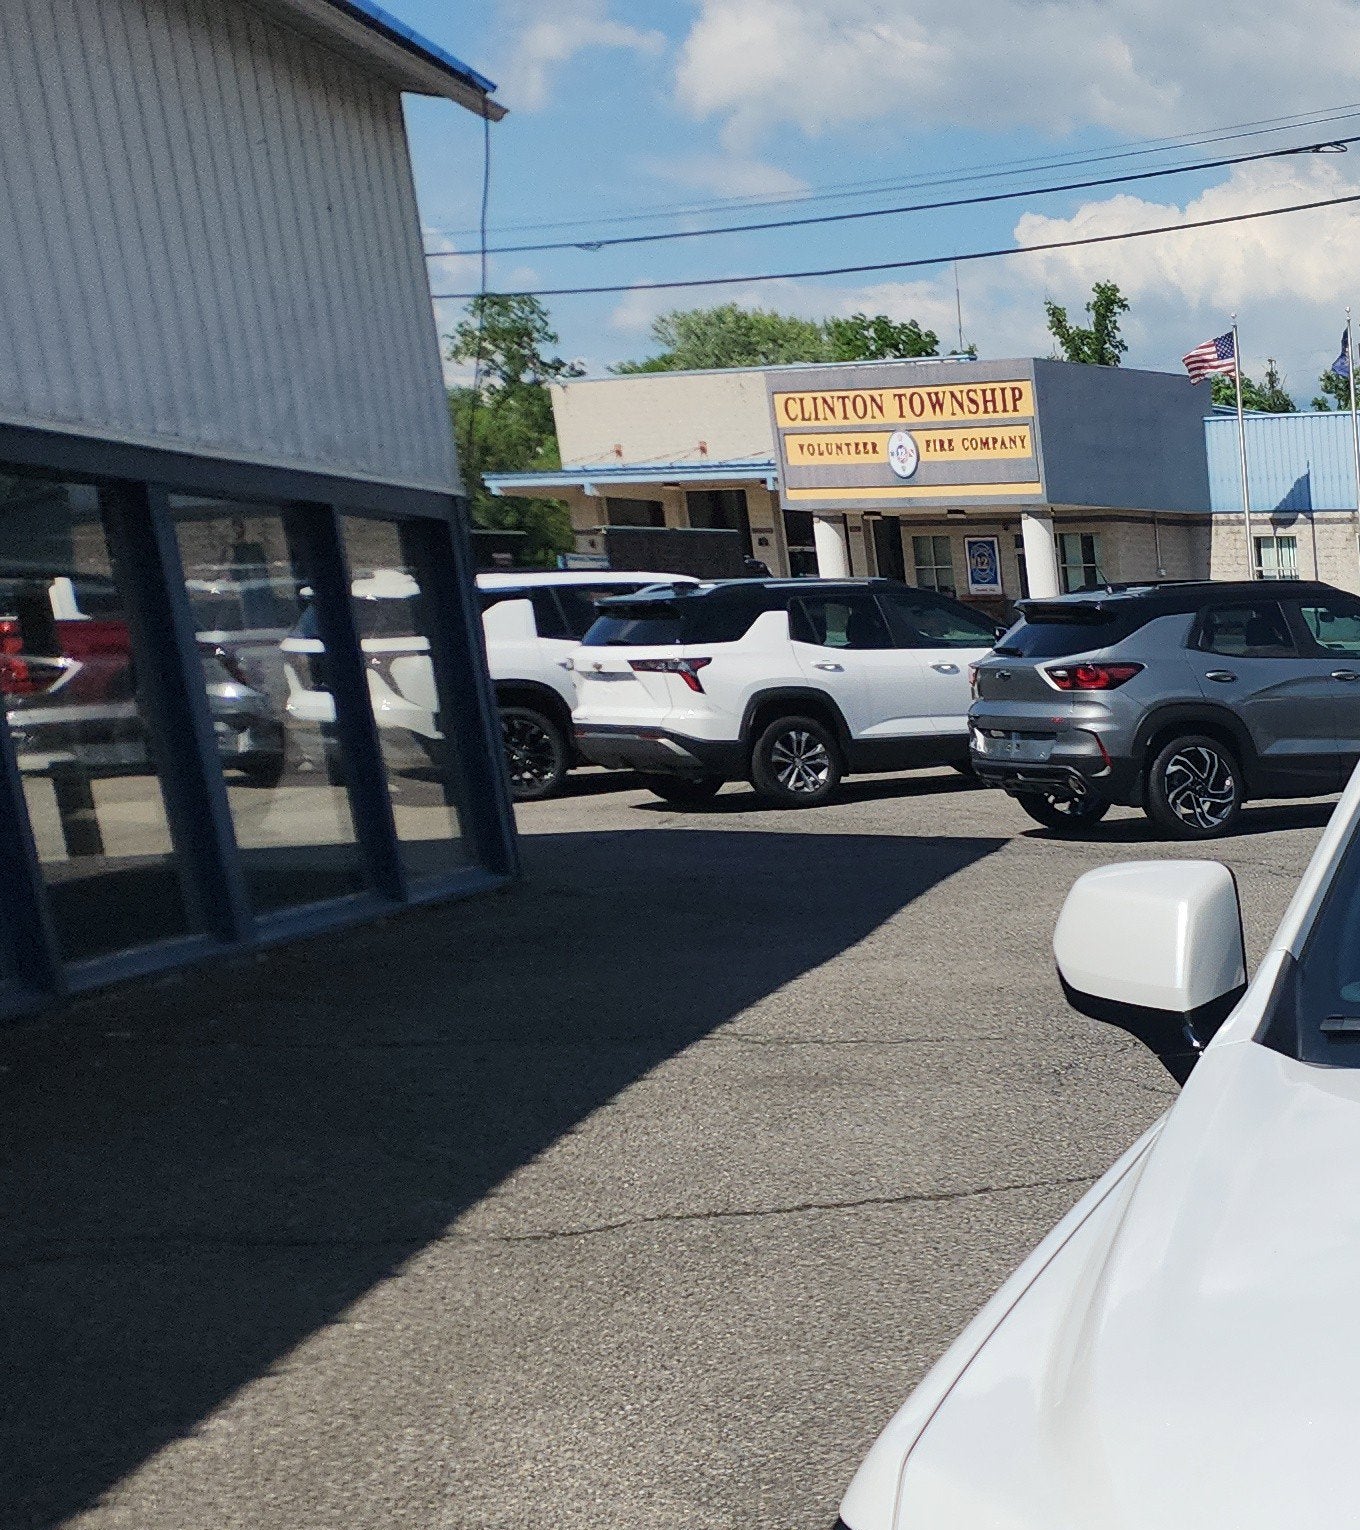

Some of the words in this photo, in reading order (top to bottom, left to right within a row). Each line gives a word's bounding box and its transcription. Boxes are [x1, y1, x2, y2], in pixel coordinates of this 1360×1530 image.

[784, 393, 885, 422] CLINTON
[893, 386, 1024, 419] TOWNSHIP
[798, 441, 880, 456] VOLUNTEER
[925, 437, 955, 453] FIRE
[961, 434, 1027, 451] COMPANY
